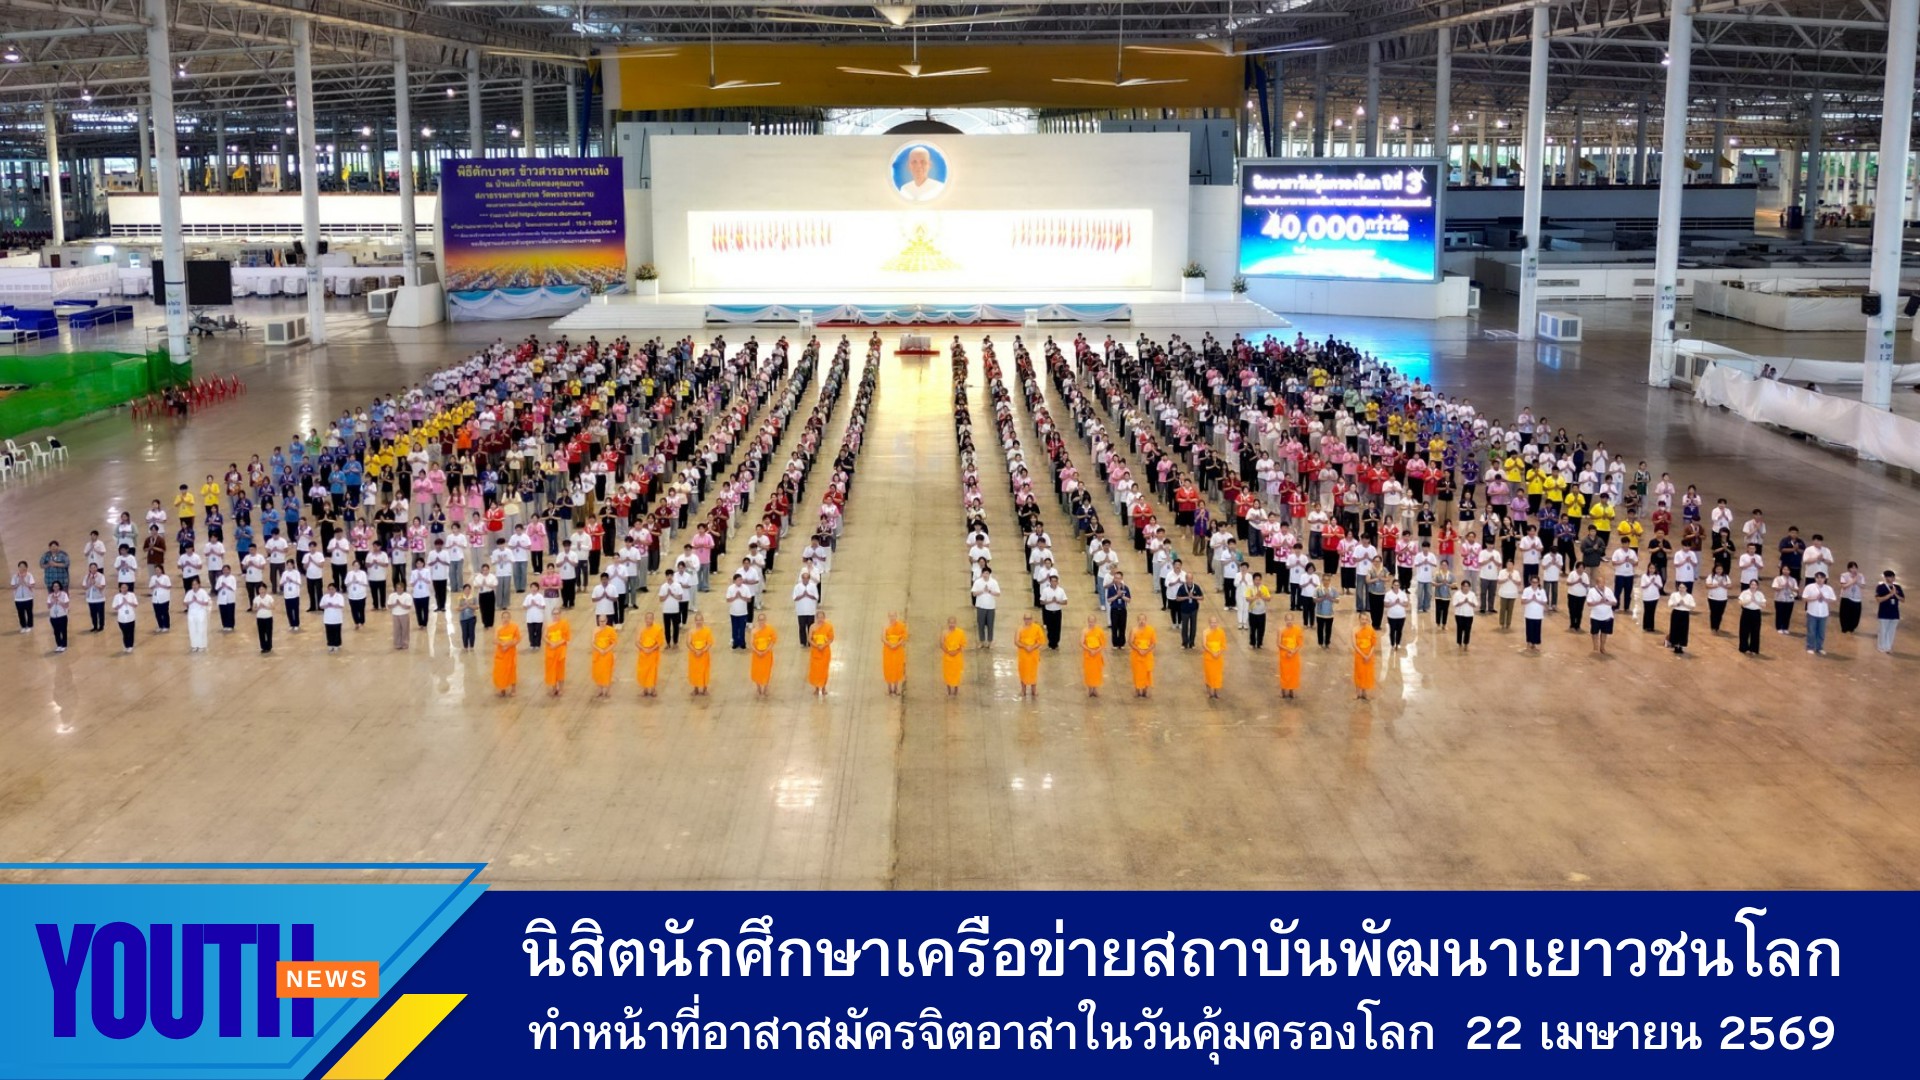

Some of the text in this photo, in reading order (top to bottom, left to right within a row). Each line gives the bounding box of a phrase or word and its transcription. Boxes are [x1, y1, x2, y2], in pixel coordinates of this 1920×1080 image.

[456, 164, 609, 177] พิธีตักบาตร ข้าวสารอาหารแห้ง
[1405, 171, 1423, 195] 3
[1261, 214, 1365, 243] 40,000
